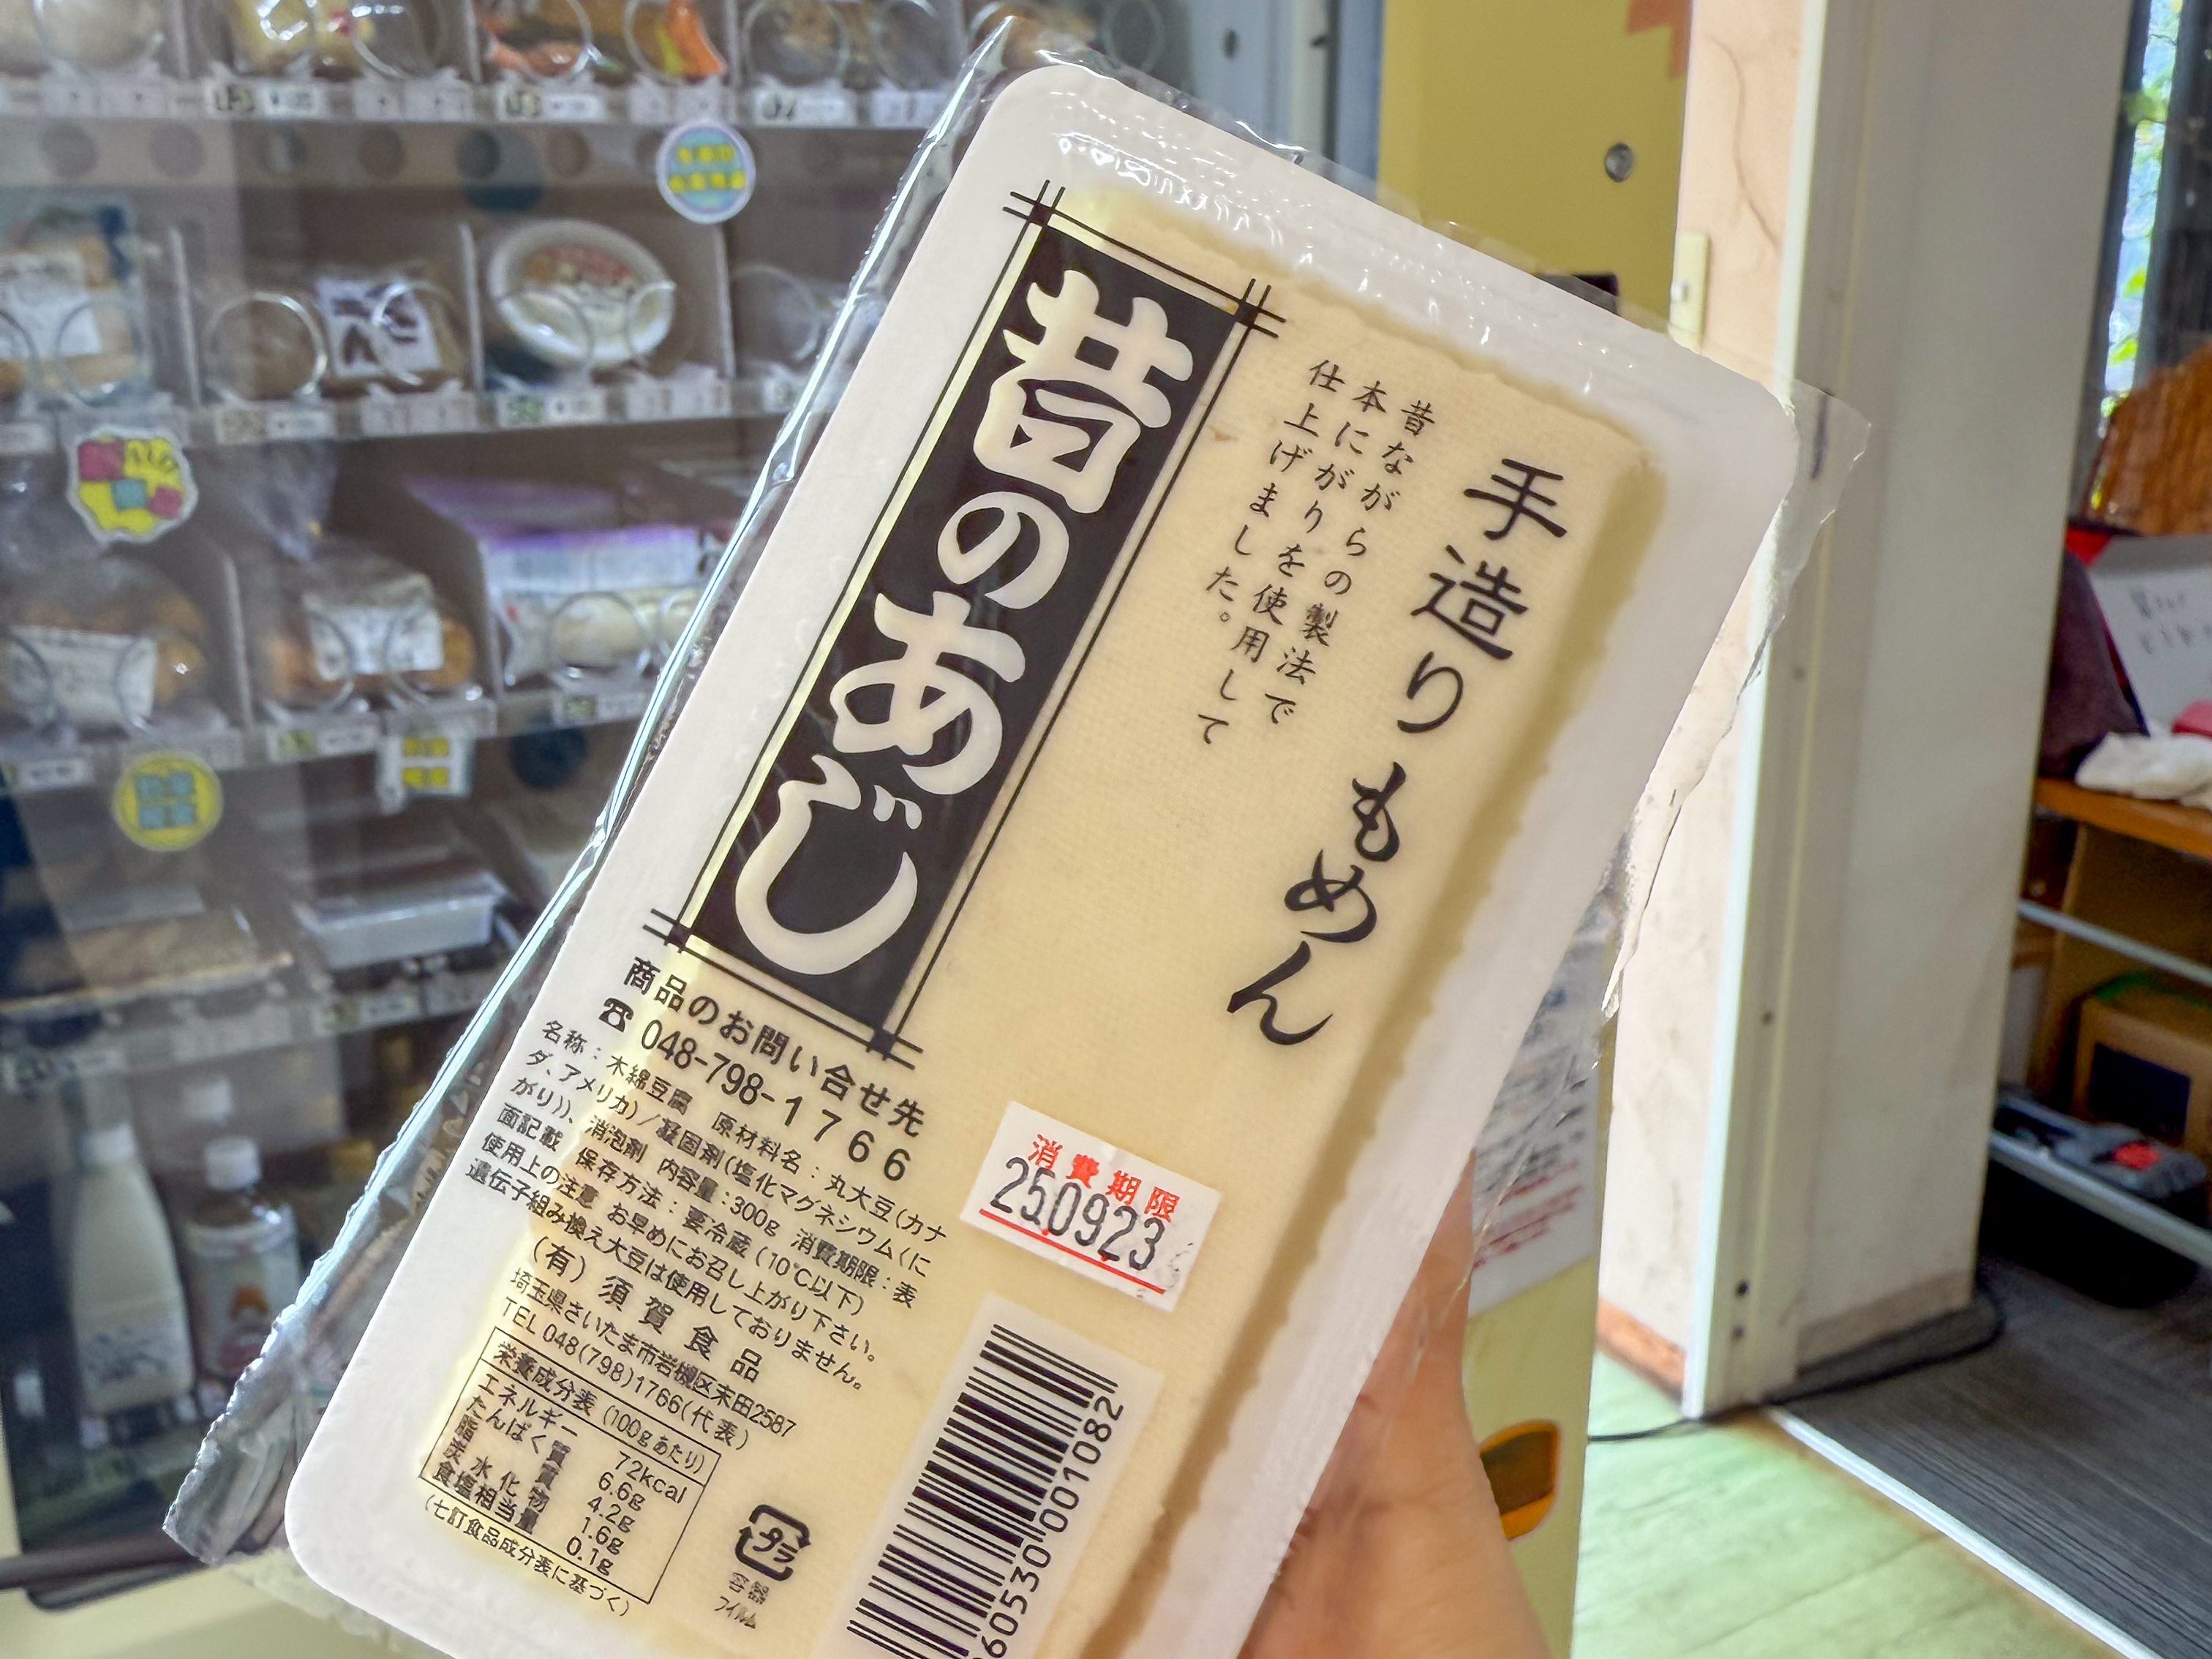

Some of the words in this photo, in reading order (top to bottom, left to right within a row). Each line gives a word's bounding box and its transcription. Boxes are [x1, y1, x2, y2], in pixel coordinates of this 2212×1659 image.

[1205, 358, 1346, 624] 仕上げました。
[734, 269, 1195, 976] 昔のあじ
[1197, 379, 1388, 746] 本にがりを使用して
[1264, 399, 1437, 726] 昔ながらの製法で
[1226, 457, 1569, 1047] 手造りもめん
[622, 955, 925, 1138] 商品のお問い合せ先
[496, 1102, 563, 1152] 面記載
[584, 1114, 649, 1164] 消泡剤
[1028, 1133, 1180, 1222] 消費期限
[464, 1156, 862, 1391] 遺伝子組み換え大豆は使用しておりません。
[480, 1131, 600, 1210] 使用上の注意
[606, 1201, 875, 1362] お早めにお召し上がり下さい。
[990, 1156, 1165, 1271] 250923
[502, 1295, 537, 1335] TEL
[509, 1267, 797, 1437] 埼玉県さいたま市岩槻区末田2587
[477, 1372, 578, 1437] エネルギー
[614, 1449, 688, 1504] 72kcal
[492, 1342, 598, 1417] 栄養成分表
[463, 1394, 571, 1469] たんぱく質
[597, 1470, 646, 1511] 6.6g
[424, 1494, 629, 1617] (七訂食品成分表に基づく)
[431, 1460, 540, 1535] 食塩相当量
[565, 1535, 614, 1576] 0.1g
[581, 1516, 624, 1556] 1.6g
[587, 1495, 636, 1534] 4.2g
[752, 1526, 800, 1566] プラ
